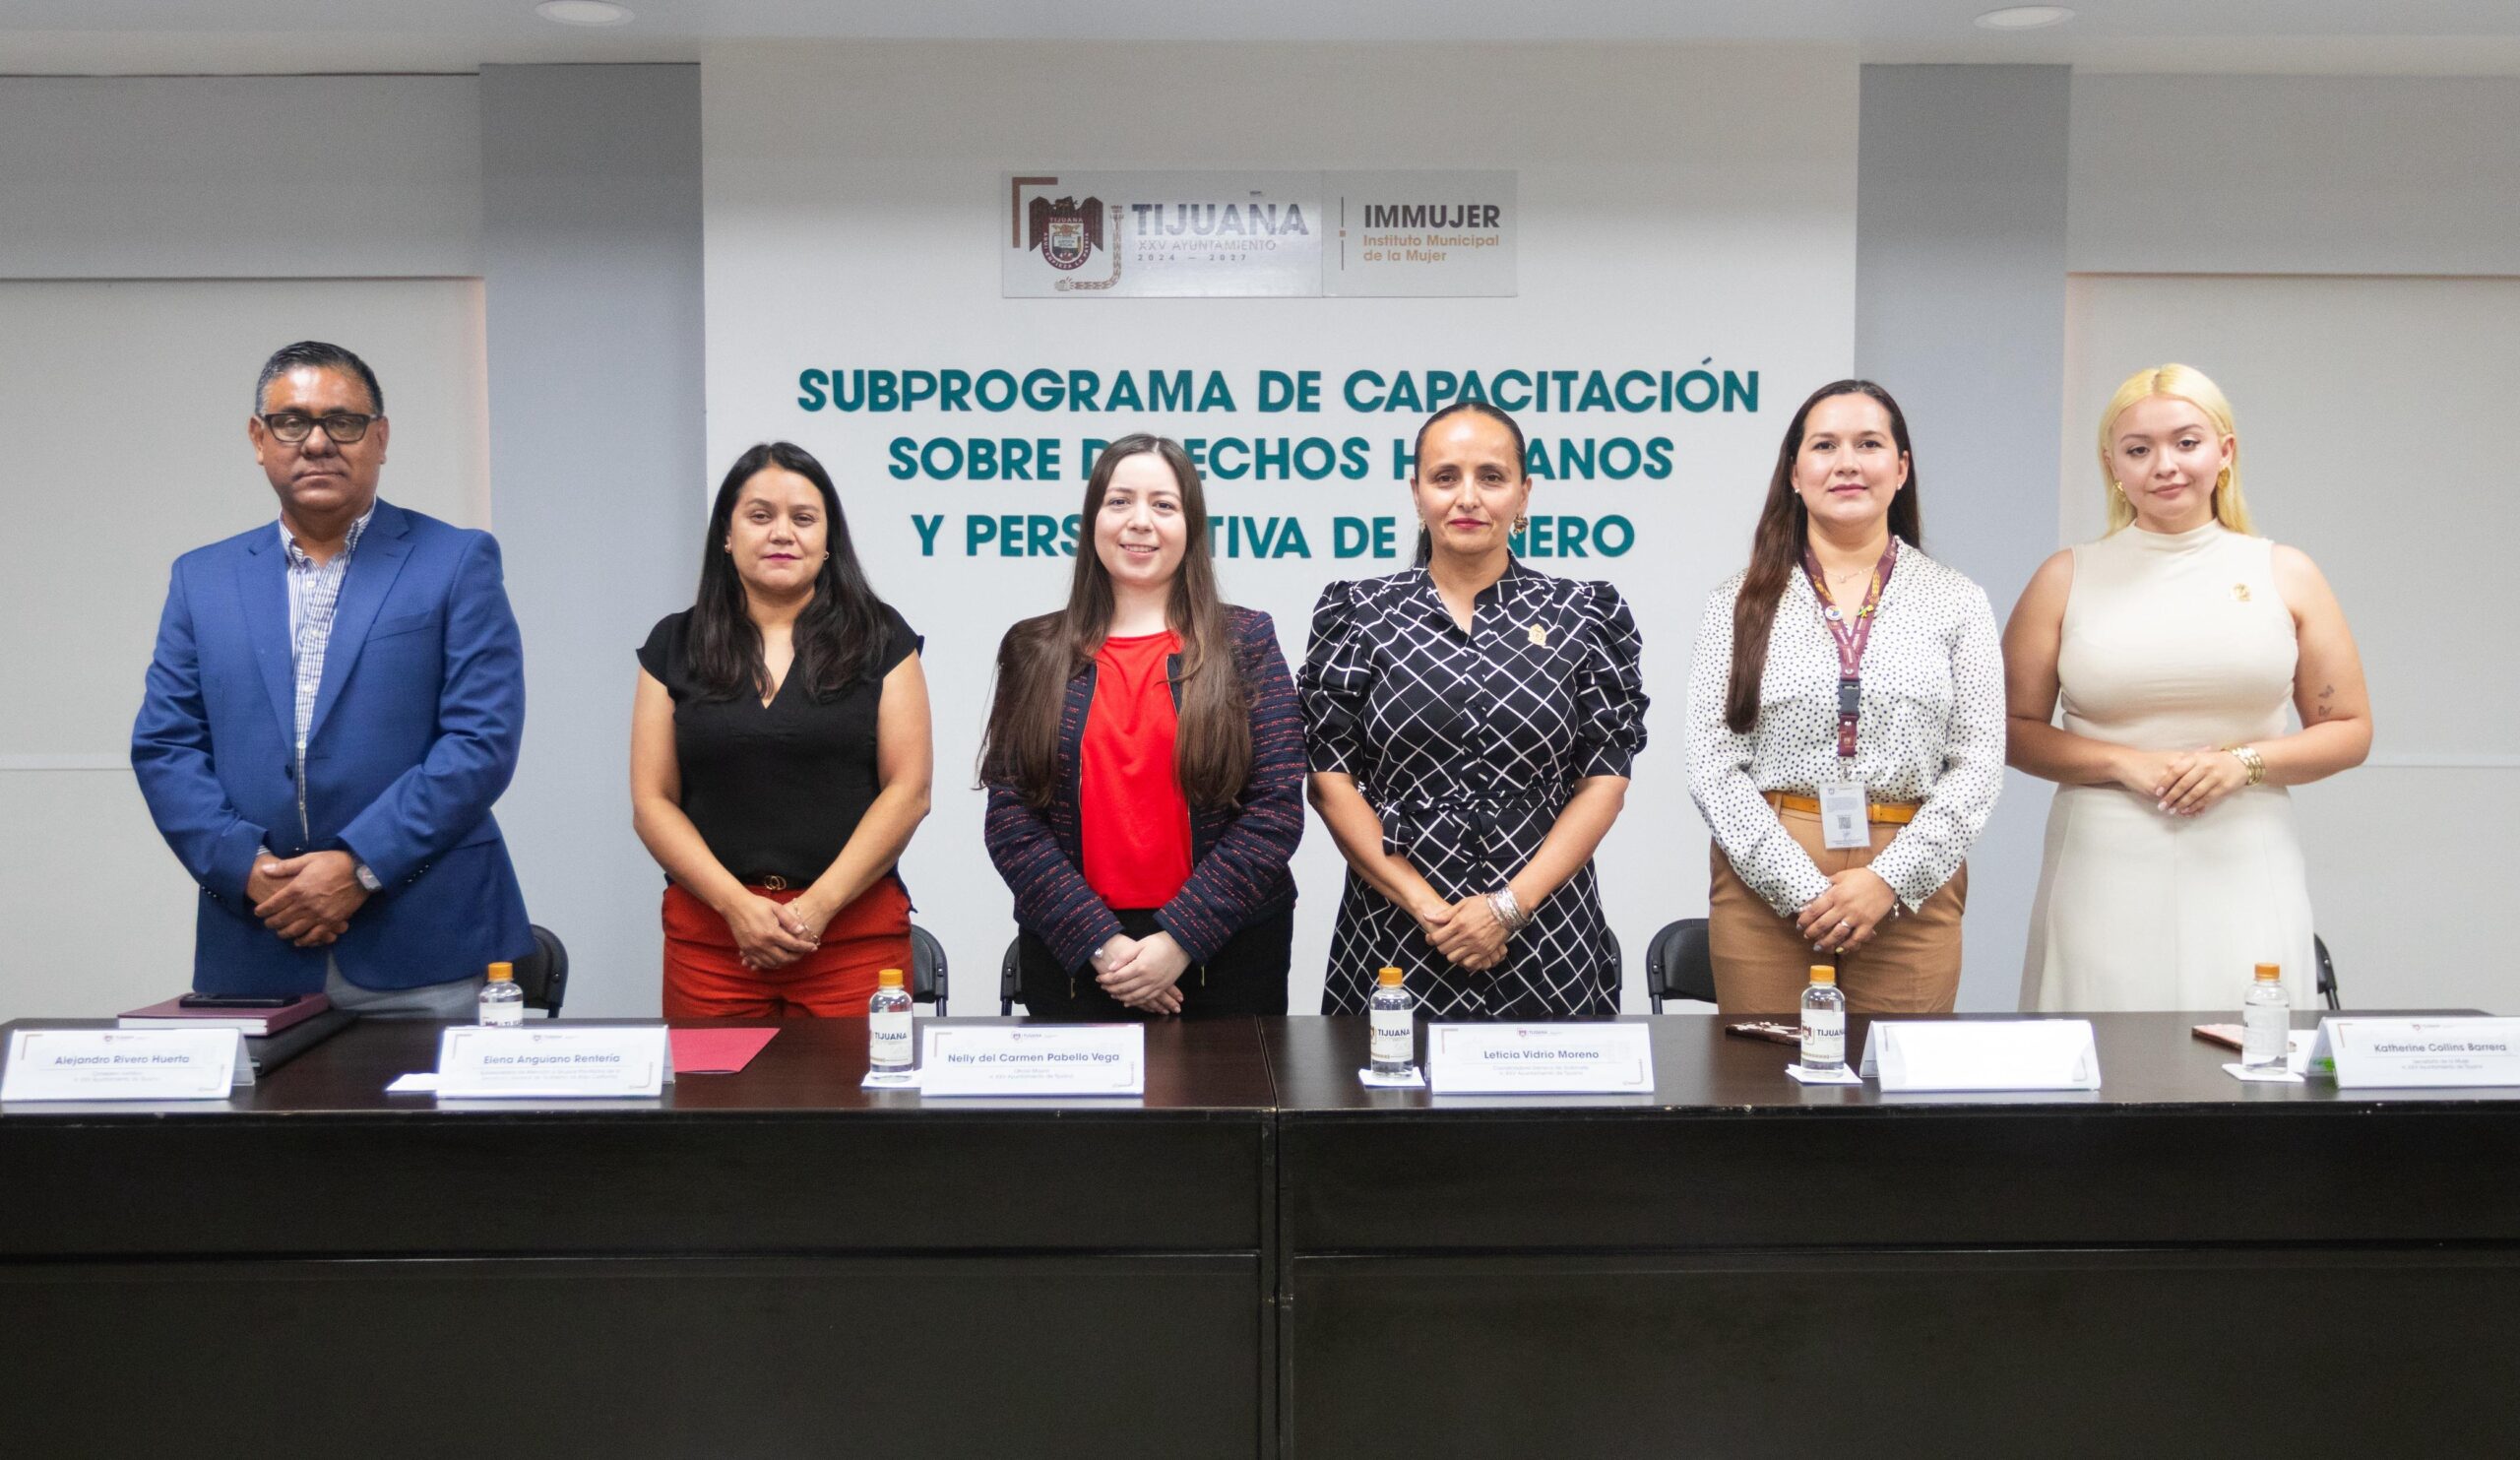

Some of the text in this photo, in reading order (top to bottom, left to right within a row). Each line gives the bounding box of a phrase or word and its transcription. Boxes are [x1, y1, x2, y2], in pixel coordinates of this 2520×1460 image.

[1132, 203, 1309, 235] TIJUANA
[1364, 204, 1501, 228] IMMUJER
[1138, 239, 1277, 251] XXV AYUNTAMIENTO
[1363, 234, 1499, 249] Instituto Municipal
[1137, 253, 1175, 262] 2024
[1209, 253, 1247, 262] 2027
[1363, 250, 1447, 264] de la Mujer
[797, 356, 1760, 413] SUBPROGRAMA DE CAPACITACIÓN
[888, 436, 1674, 480] SOBRE DECHOS HANOS
[912, 514, 1635, 559] Y PERSTIVA DE ERO
[874, 1032, 908, 1041] TIJUANA
[1377, 1028, 1411, 1037] TIJUANA
[2374, 1043, 2507, 1052] Katherine Collins Barrera
[54, 1054, 190, 1066] Alejandro Rivero Huerta
[483, 1055, 514, 1064] Elena
[517, 1054, 571, 1066] Anguiano
[948, 1052, 1119, 1064] Nelly del Carmen Pabello Vega
[1483, 1050, 1600, 1059] Leticia Vidrio Moreno
